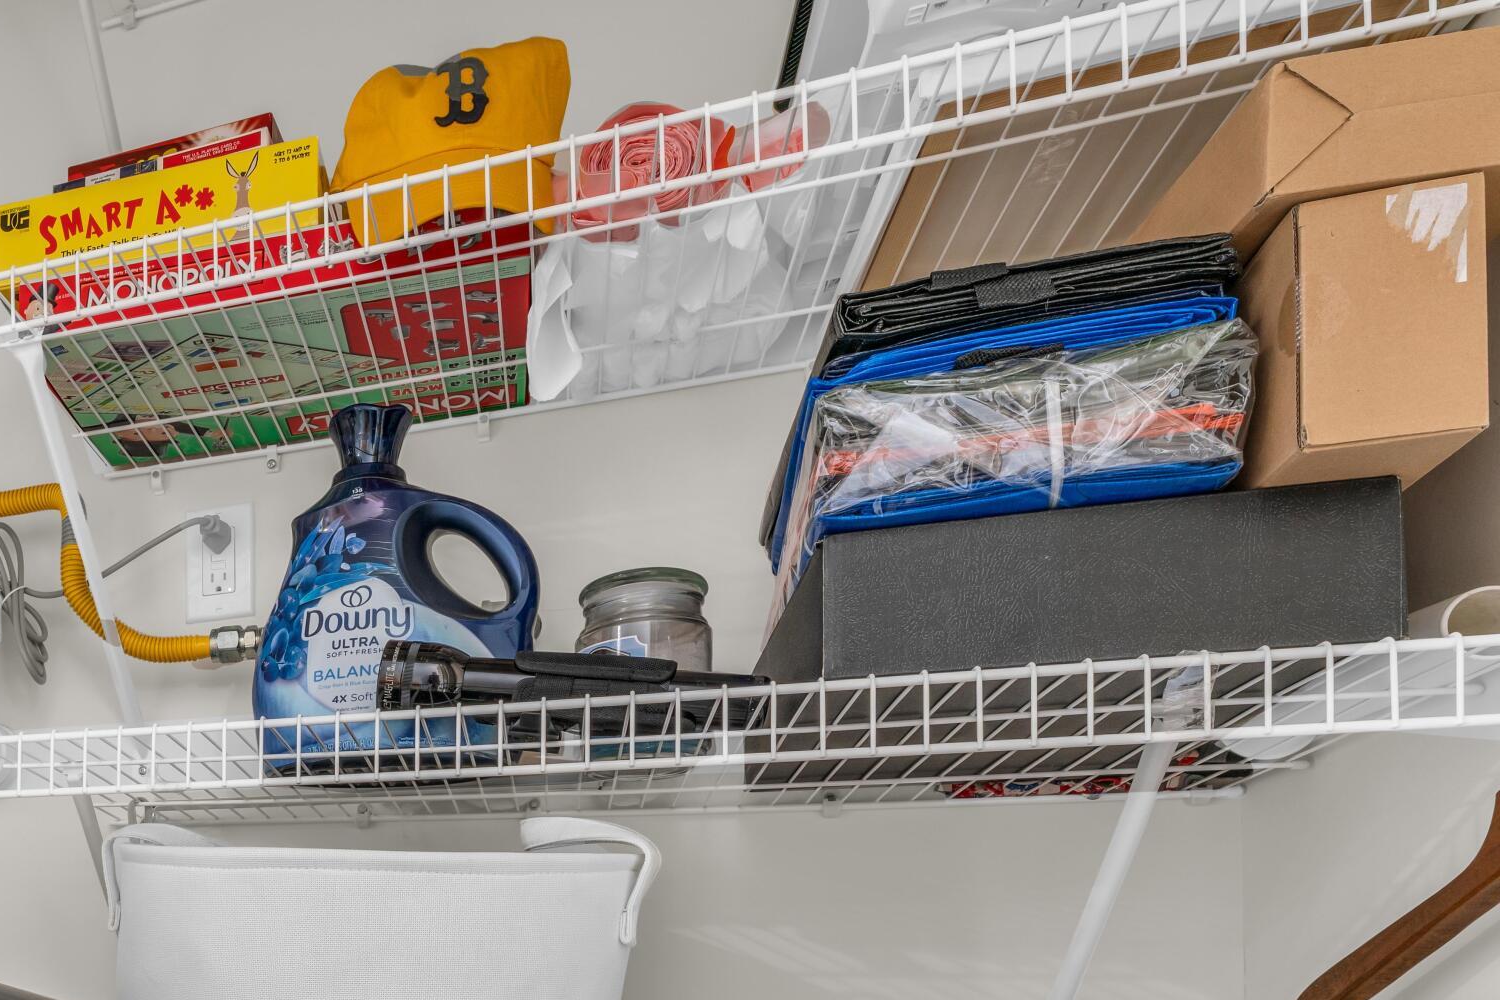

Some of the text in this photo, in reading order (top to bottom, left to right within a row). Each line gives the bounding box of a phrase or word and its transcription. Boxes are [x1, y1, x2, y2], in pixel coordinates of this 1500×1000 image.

[434, 56, 489, 127] B
[201, 146, 219, 155] PLAYING
[39, 197, 144, 256] SMART
[86, 256, 259, 308] MONOPOLY
[304, 606, 411, 638] Downy
[331, 636, 379, 650] ULTRA
[313, 664, 381, 683] BALANC
[332, 693, 347, 704] 4X
